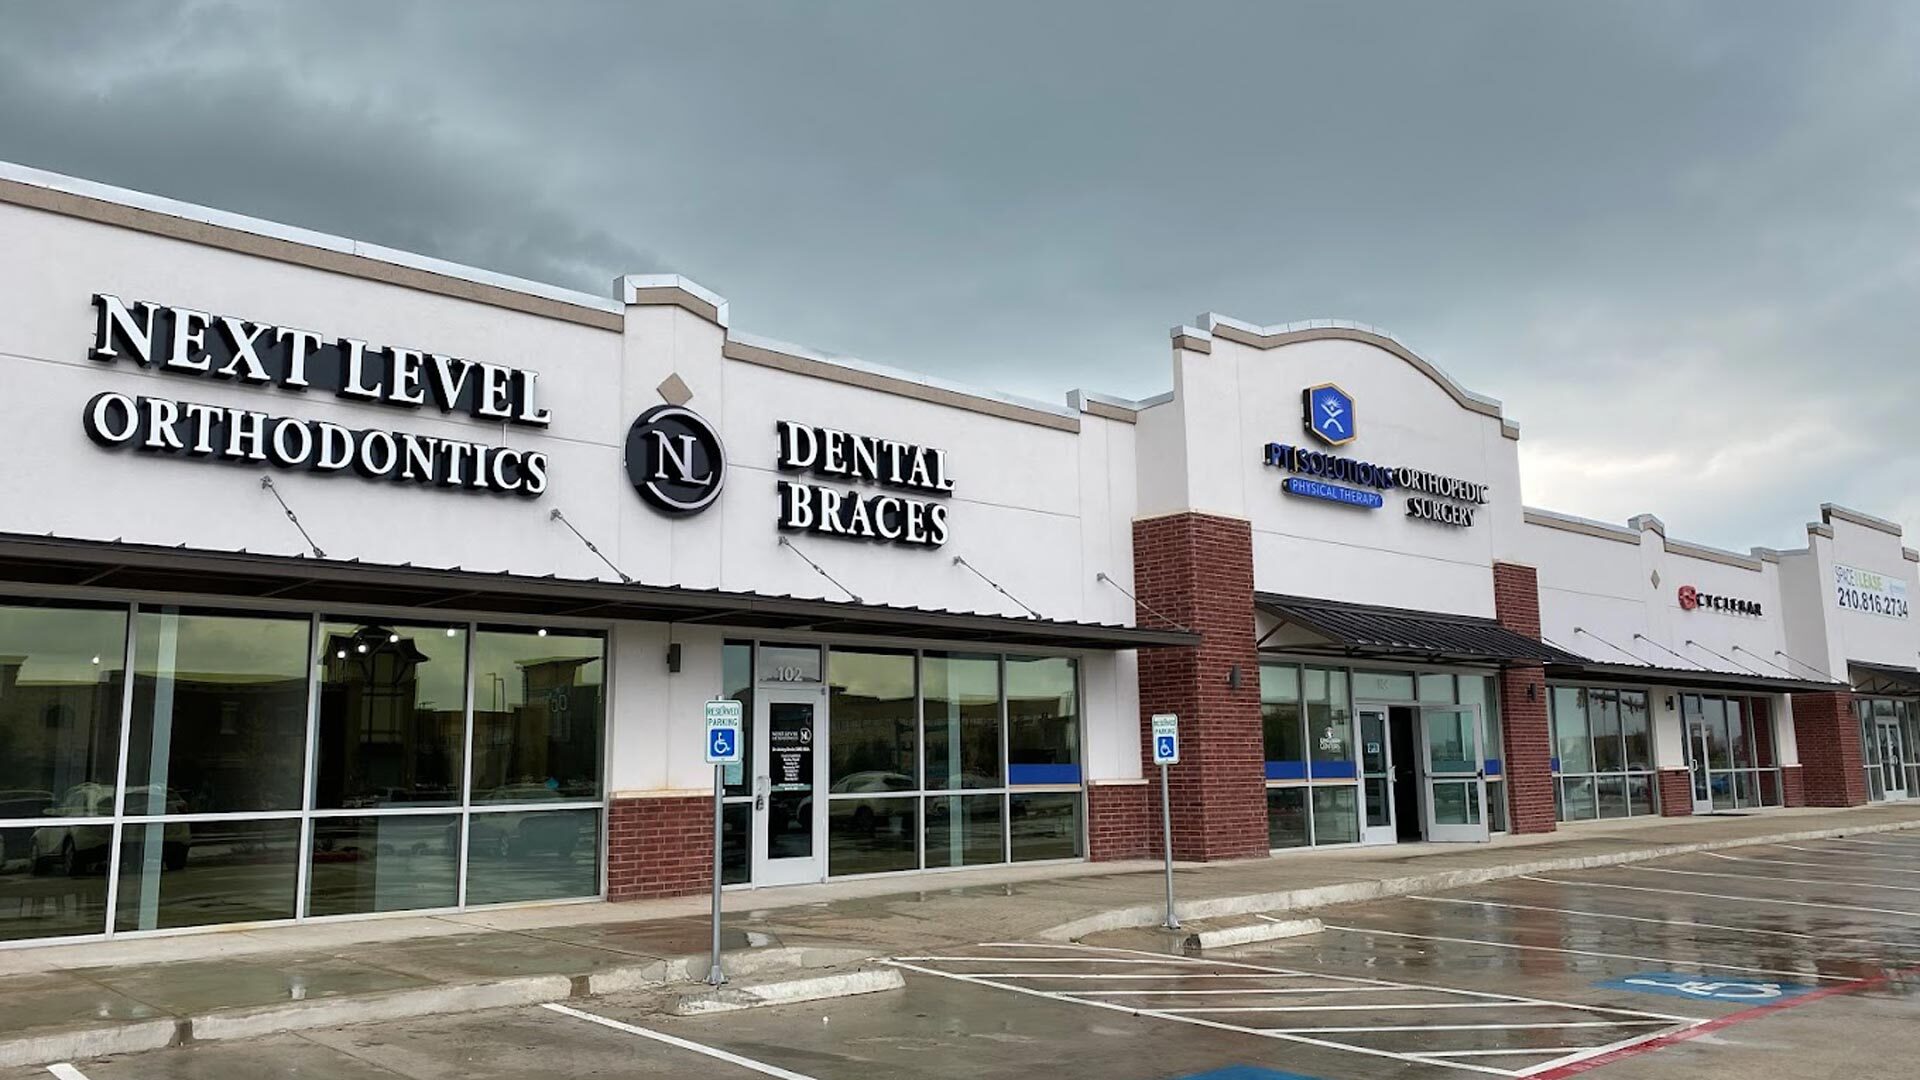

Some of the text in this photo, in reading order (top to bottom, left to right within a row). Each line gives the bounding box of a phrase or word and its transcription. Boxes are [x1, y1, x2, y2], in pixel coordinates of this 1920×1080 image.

[92, 293, 552, 427] NEXT LEVEL
[89, 391, 548, 495] ORTHODONTICS
[652, 430, 713, 486] NL
[784, 421, 956, 490] DENTAL
[1292, 479, 1379, 505] PHYSICAL THERAPY
[1398, 467, 1490, 504] ORTHOPEDIC
[784, 482, 949, 546] BRACES
[1411, 497, 1475, 527] SURGERY
[1696, 592, 1763, 616] CYCLEBAR
[1837, 587, 1909, 618] 210.816.2734
[777, 665, 803, 682] 102
[706, 705, 739, 716] RESERVED
[708, 717, 738, 727] PARKING
